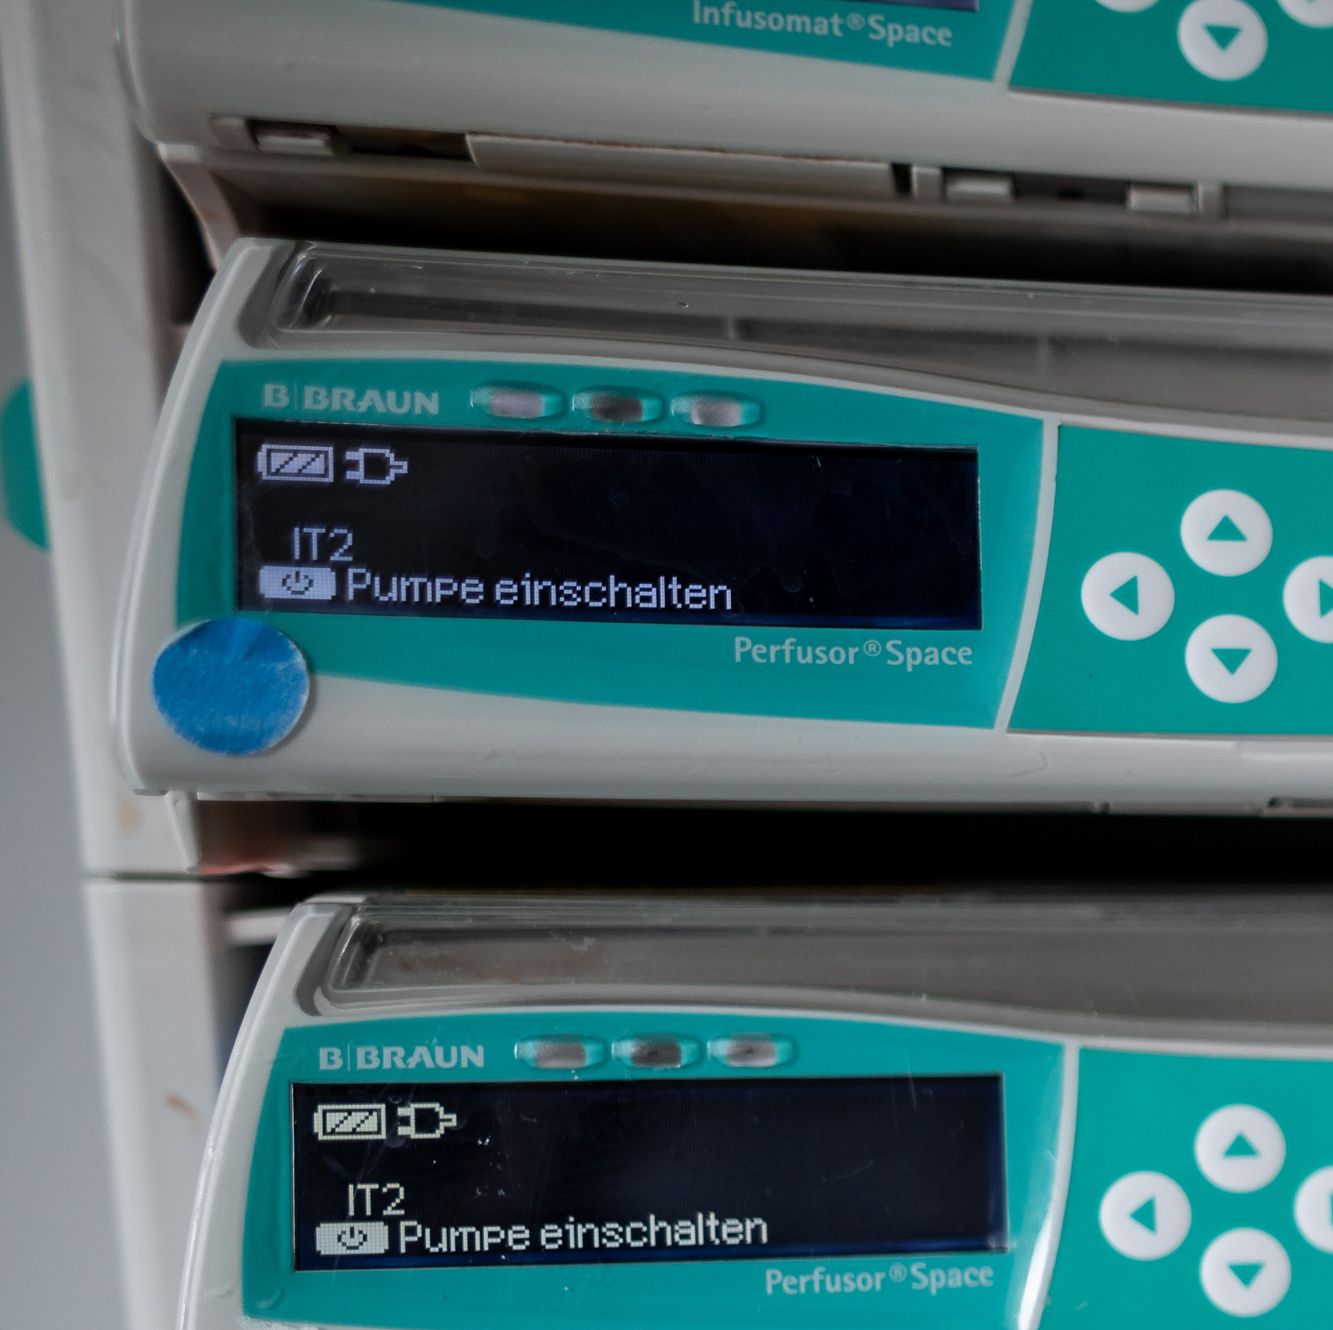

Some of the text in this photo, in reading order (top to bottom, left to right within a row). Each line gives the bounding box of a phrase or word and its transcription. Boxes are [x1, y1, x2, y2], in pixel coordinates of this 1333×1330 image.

[867, 14, 953, 47] Space
[303, 385, 440, 415] BRAUN
[293, 527, 354, 562] IT2
[347, 568, 732, 610] Pumpe einschalten
[886, 639, 973, 672] Space
[356, 1045, 485, 1070] BRAUN
[348, 1183, 405, 1217] IT2
[399, 1211, 768, 1253] Pumpe einschalten
[910, 1262, 994, 1296] Space
